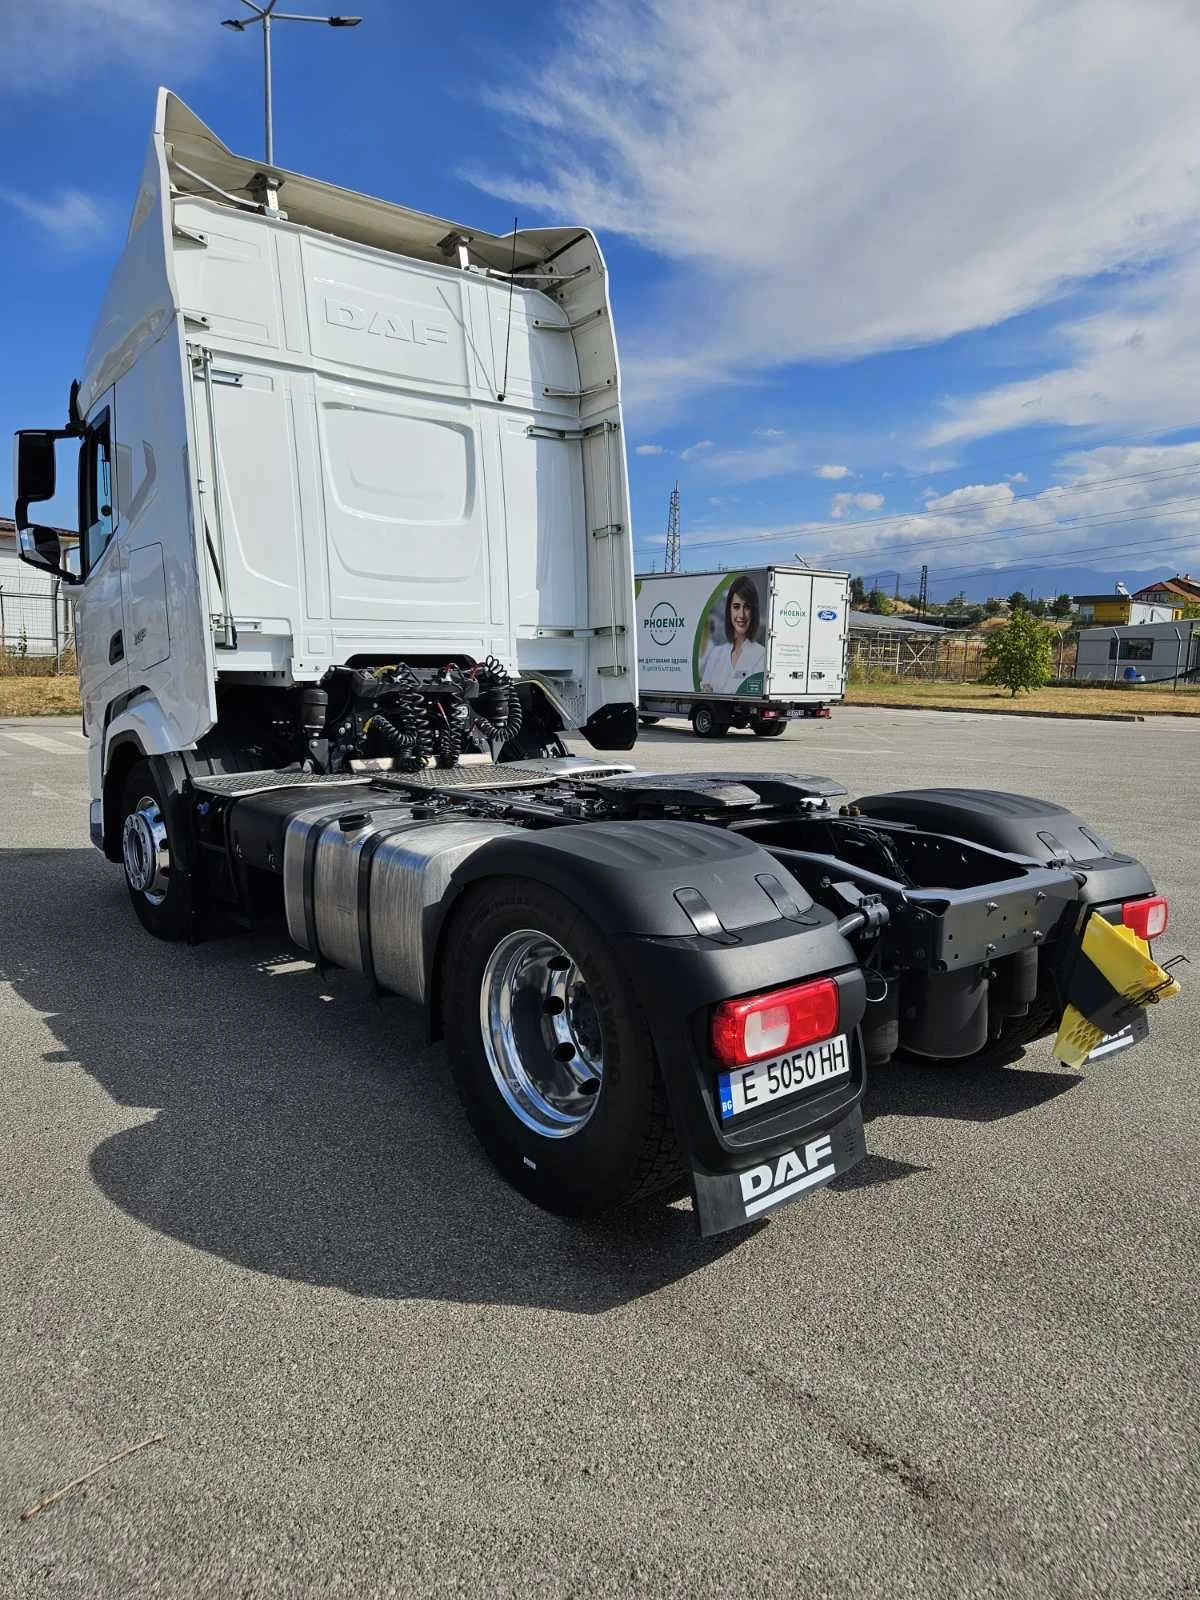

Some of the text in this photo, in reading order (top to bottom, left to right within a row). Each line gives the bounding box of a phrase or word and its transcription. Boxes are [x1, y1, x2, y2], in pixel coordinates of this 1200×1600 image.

[324, 296, 448, 346] DAF
[643, 617, 685, 629] PHOENIX
[779, 609, 806, 617] PHOENIX
[742, 1040, 845, 1104] E 5050 HH
[722, 1100, 732, 1113] BG
[739, 1134, 832, 1202] DAF
